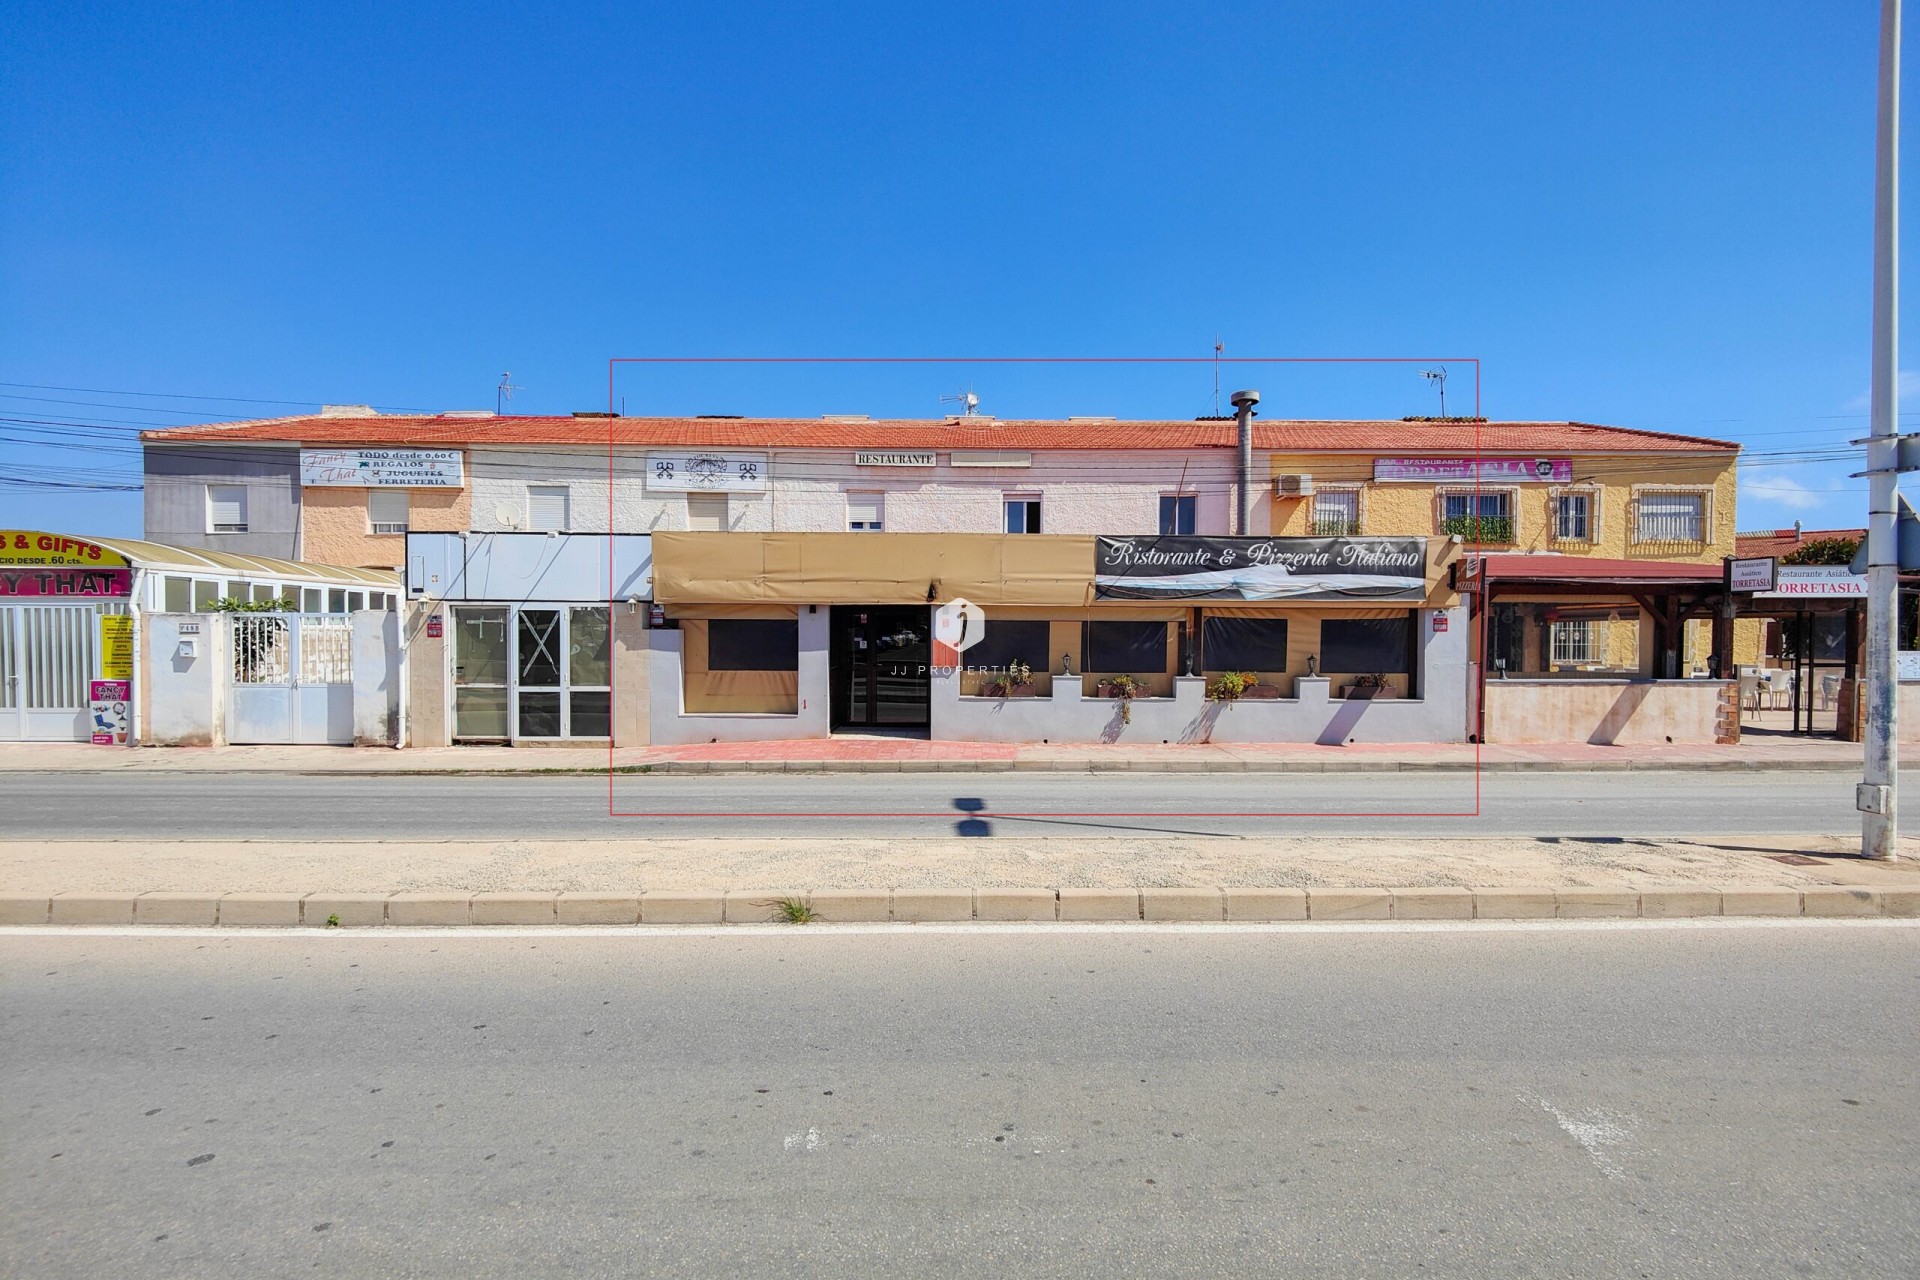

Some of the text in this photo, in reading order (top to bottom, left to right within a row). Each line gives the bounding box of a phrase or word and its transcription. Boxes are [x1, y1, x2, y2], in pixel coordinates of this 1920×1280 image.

[358, 451, 389, 459] TODO
[392, 451, 422, 459] desde
[858, 454, 934, 464] RESTAURANTE
[302, 452, 347, 472] Fancy
[319, 468, 356, 482] That
[378, 477, 447, 485] FERRETERÍA
[14, 534, 31, 549] &
[37, 536, 102, 561] GIFTS
[1104, 541, 1420, 572] Ristorante & Pizzeria Italiano
[1735, 561, 1768, 569] Restaurante
[1740, 569, 1762, 577] Asiático
[1777, 570, 1823, 578] Restaurante
[34, 572, 117, 594] THAT
[1732, 578, 1771, 589] TORRETASIA
[1775, 582, 1862, 593] ORRETASIA
